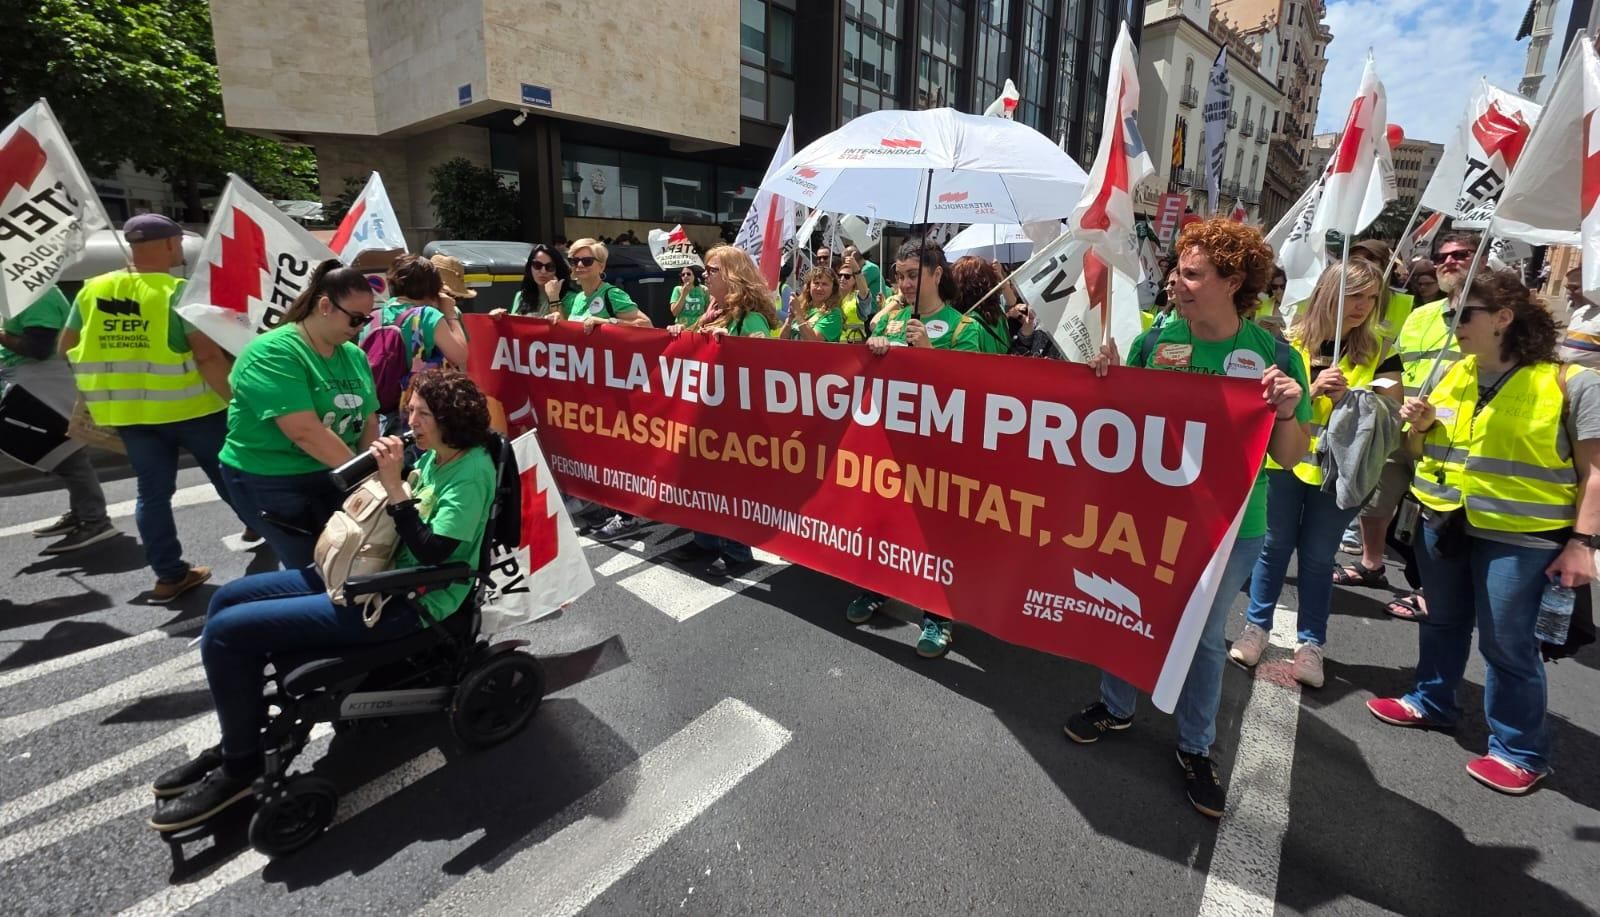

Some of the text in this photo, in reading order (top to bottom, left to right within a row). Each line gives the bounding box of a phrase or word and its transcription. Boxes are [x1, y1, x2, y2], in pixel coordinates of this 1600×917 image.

[843, 148, 928, 156] INTERSINDICAL
[490, 336, 1207, 487] ALCEM LA VEU I DIGUEM PROU
[546, 398, 806, 474] RECLASSIFICACIÓ
[816, 444, 827, 480] I
[835, 448, 1052, 547] DIGNITAT,
[551, 453, 954, 586] PERSONAL D'ATENCIÓ EDUCATIVA I D'ADMINISTRACIÓ I SERVEIS
[1022, 603, 1064, 623] STAS
[1026, 588, 1155, 640] INTERSINDICAL
